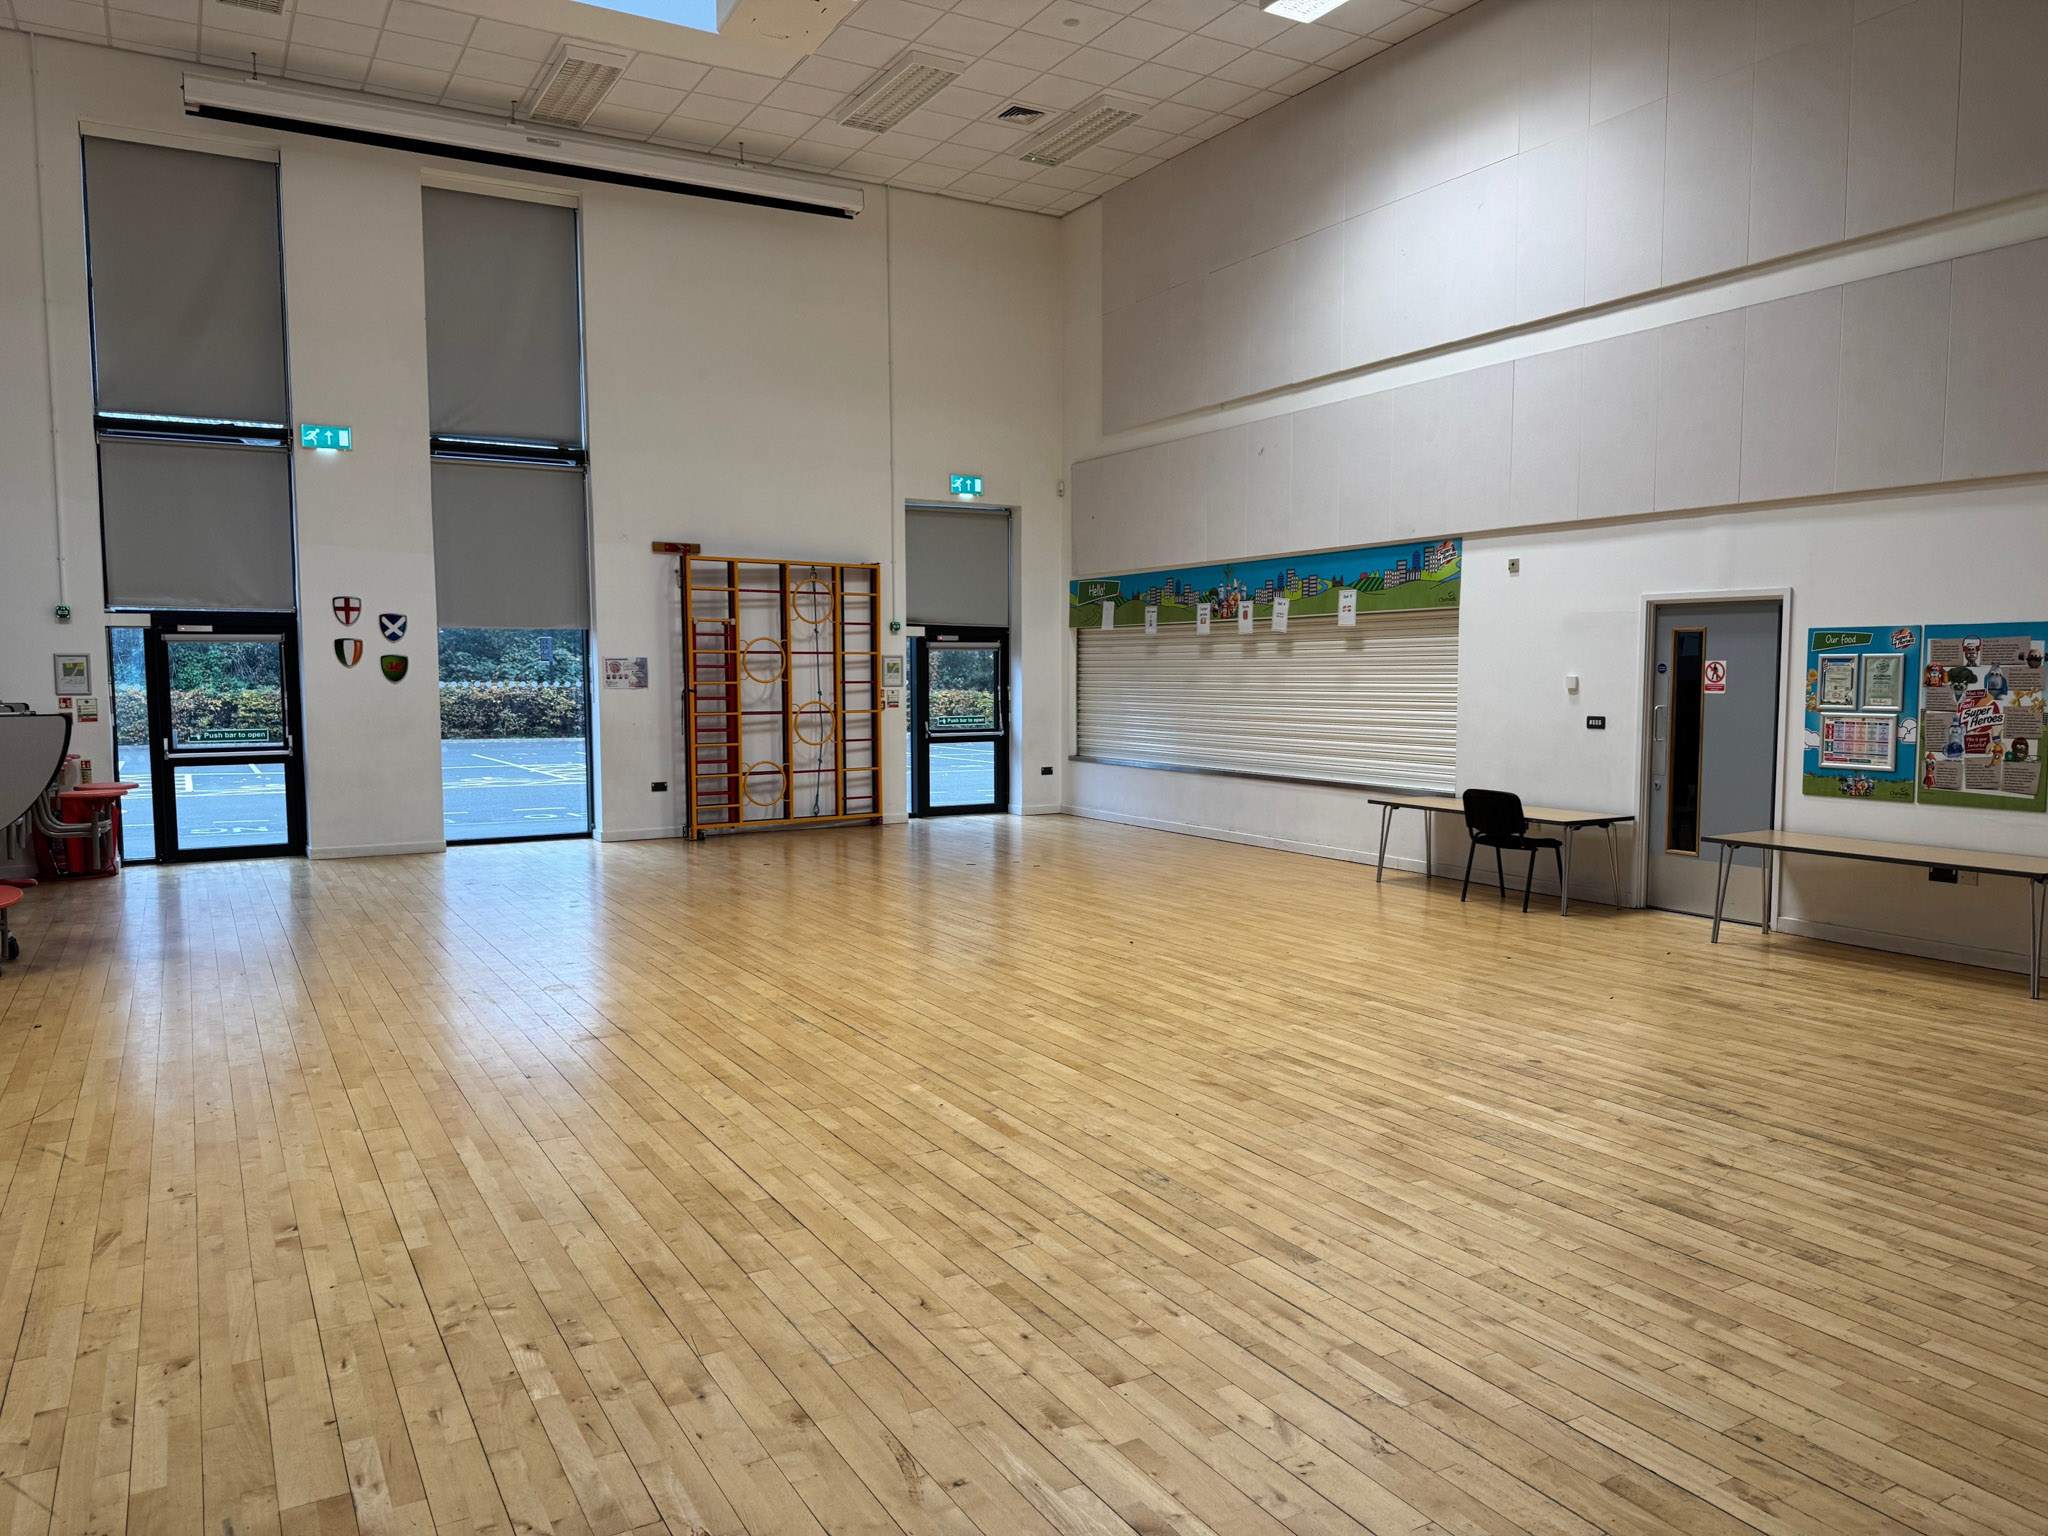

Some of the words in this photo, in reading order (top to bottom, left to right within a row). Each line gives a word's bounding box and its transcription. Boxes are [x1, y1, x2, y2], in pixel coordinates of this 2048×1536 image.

[1088, 583, 1106, 597] Hello!
[1825, 634, 1839, 644] Our
[1841, 634, 1857, 643] food
[1959, 700, 1973, 709] Food
[1963, 706, 1992, 720] Super
[1970, 715, 2003, 728] Heroes
